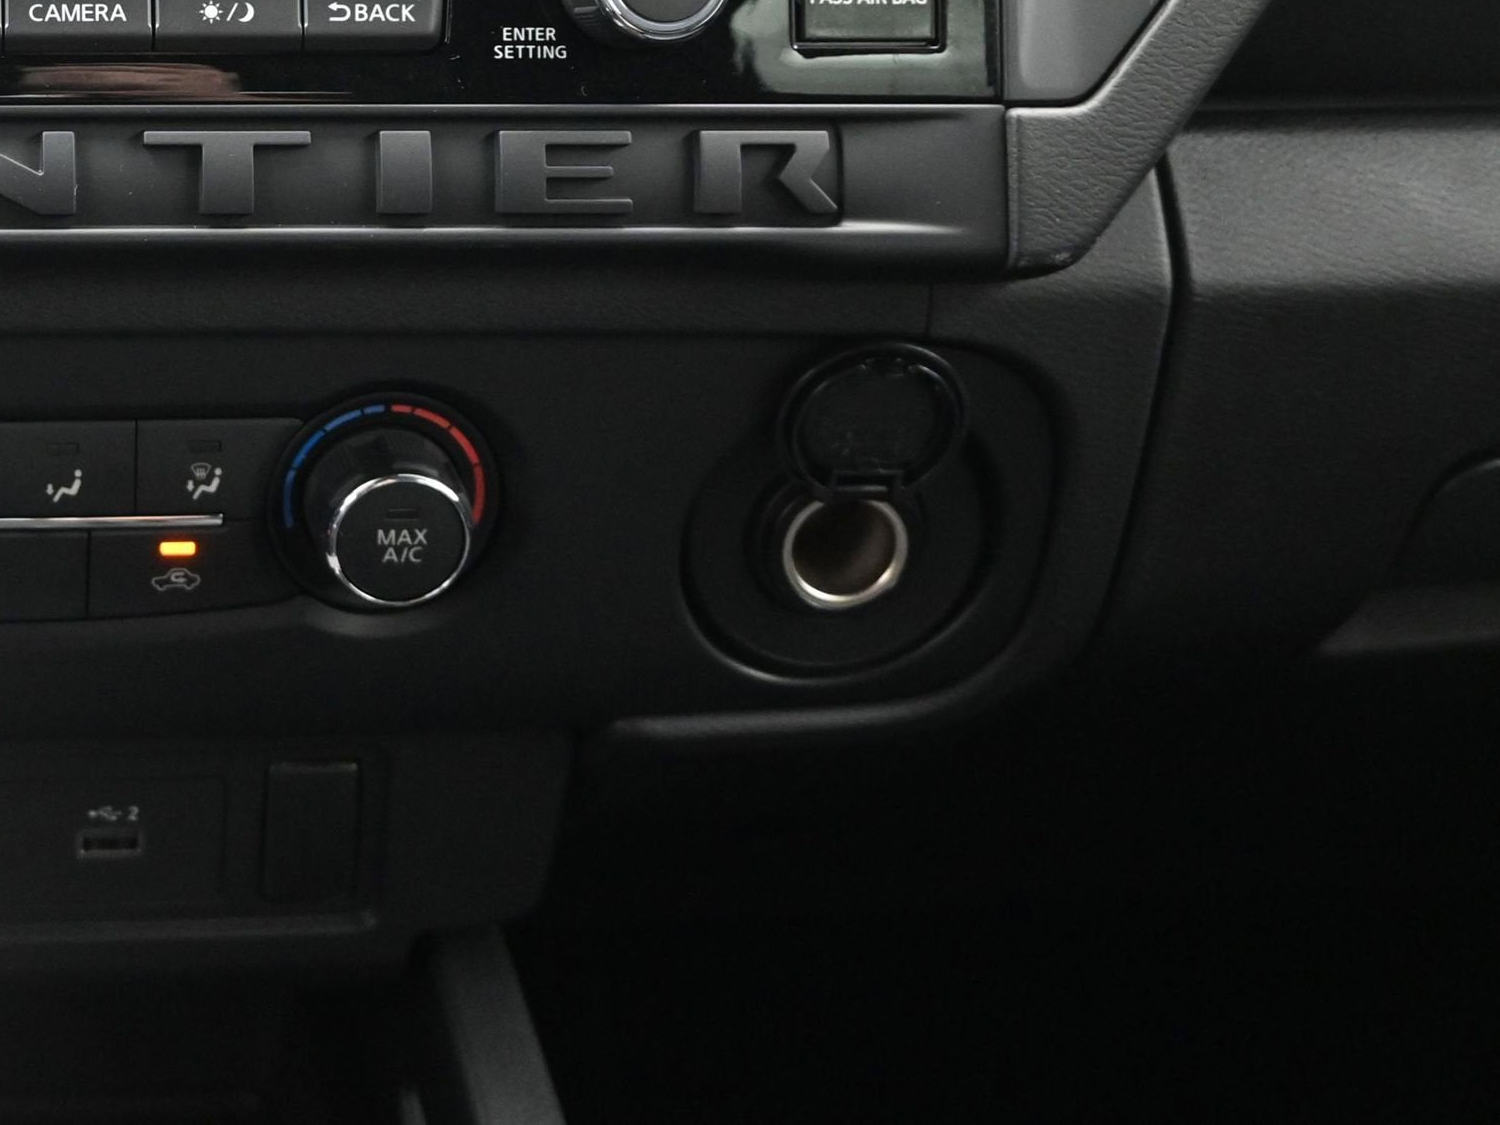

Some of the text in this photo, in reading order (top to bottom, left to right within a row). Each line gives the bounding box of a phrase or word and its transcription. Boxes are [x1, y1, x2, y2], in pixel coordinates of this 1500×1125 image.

[28, 3, 127, 22] CAMERA
[355, 3, 416, 22] BACK
[502, 27, 556, 42] ENTER
[493, 44, 567, 59] SETTING
[377, 529, 427, 547] MAX
[382, 546, 423, 563] A/C
[127, 805, 140, 822] 2
